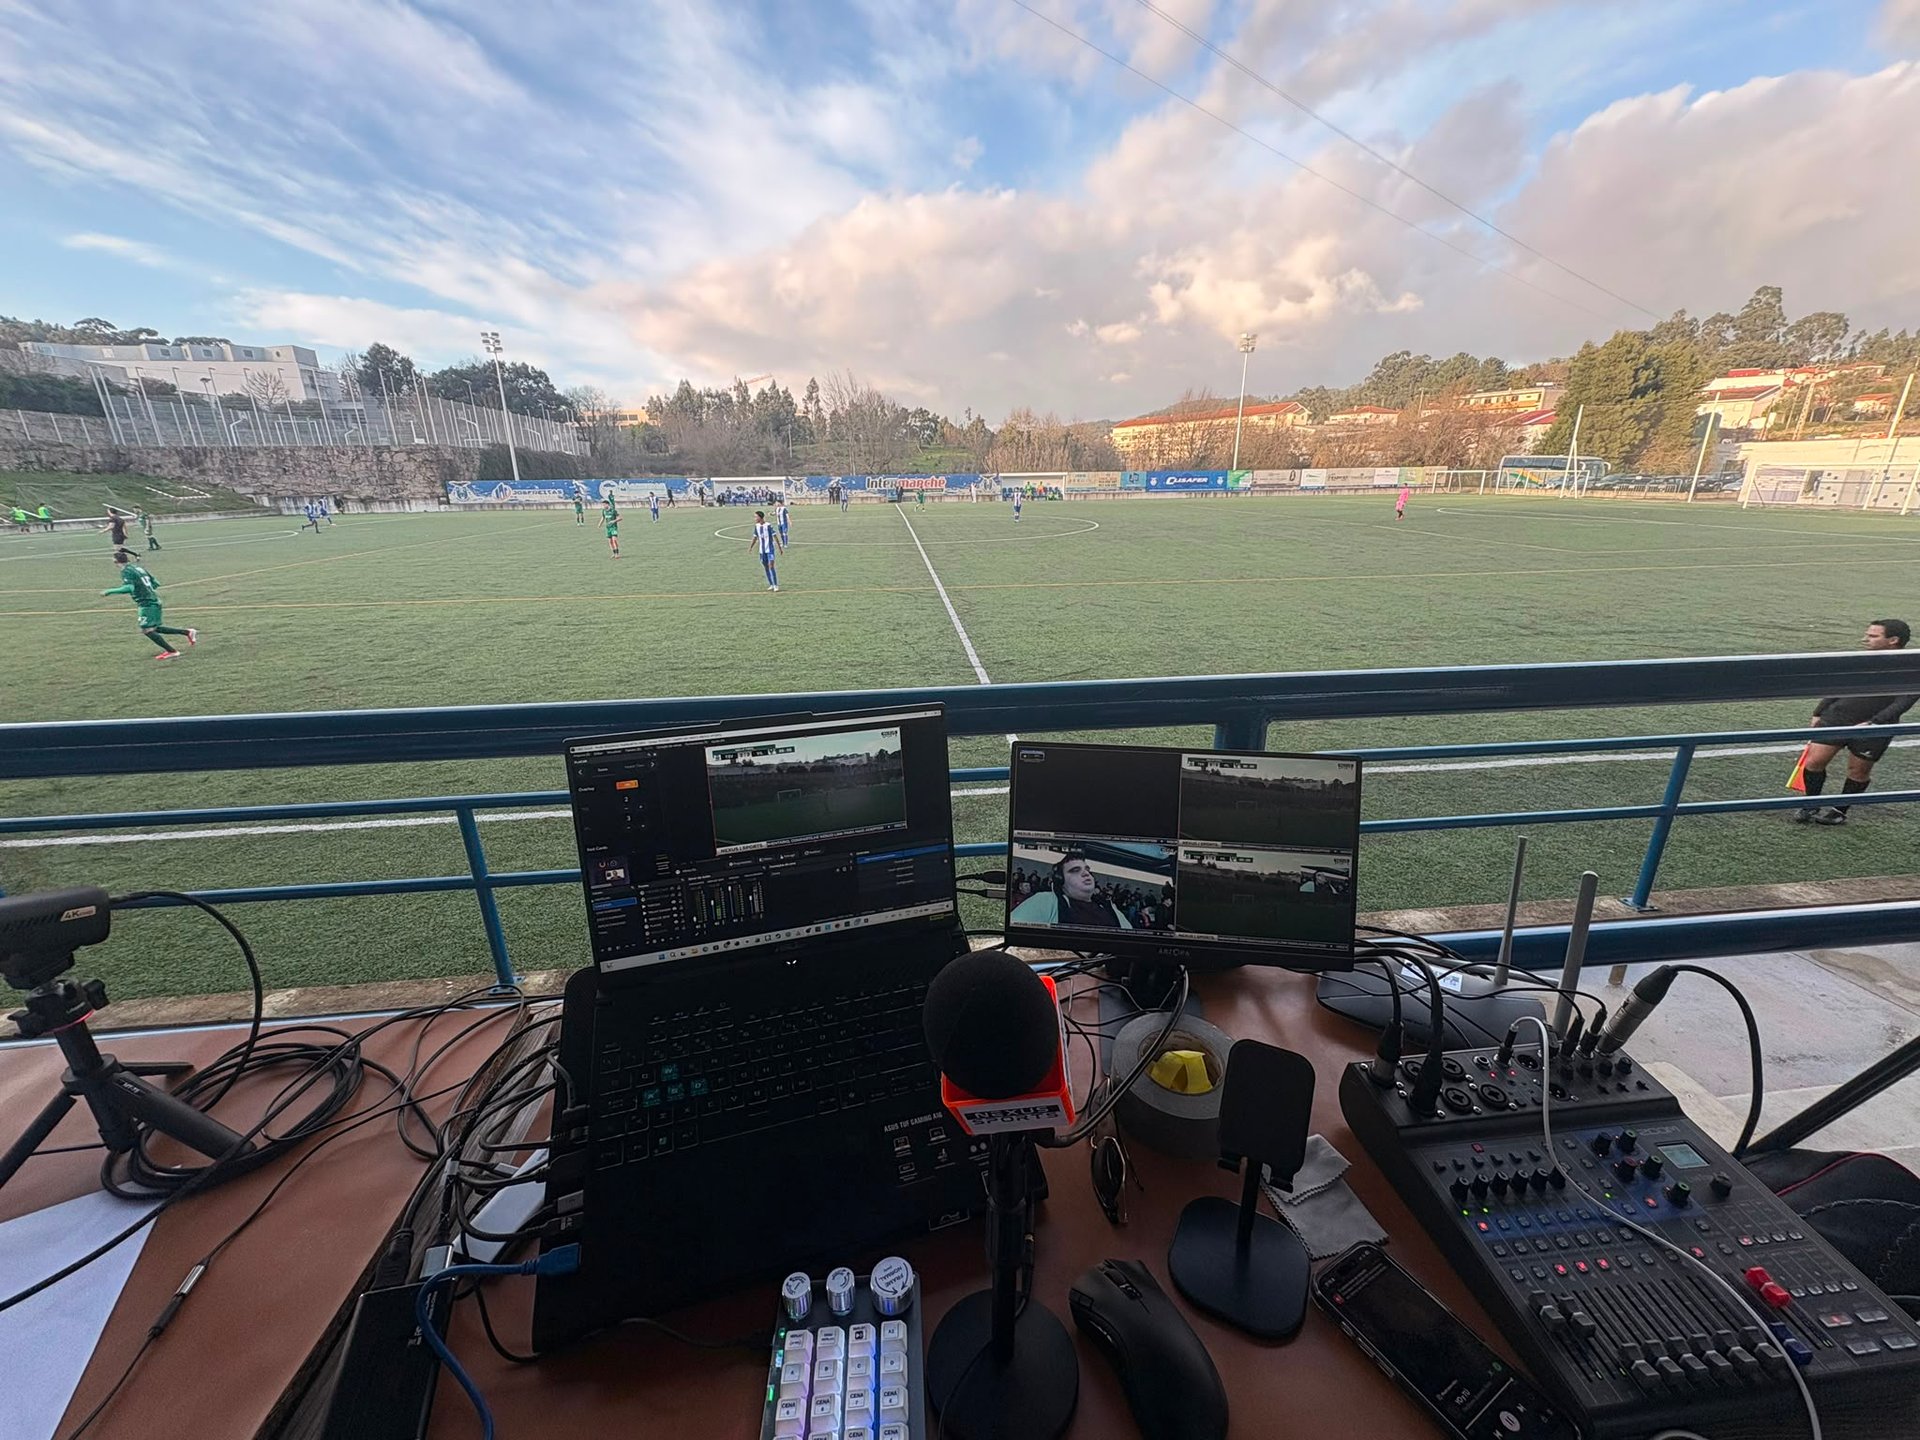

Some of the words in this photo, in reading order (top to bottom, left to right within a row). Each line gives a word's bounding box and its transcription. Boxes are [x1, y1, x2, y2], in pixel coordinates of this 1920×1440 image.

[65, 910, 79, 919] 4K
[972, 1112, 1058, 1125] SPORTS
[974, 1106, 1049, 1119] NEXUS
[883, 1121, 899, 1133] ASUS
[899, 1118, 910, 1129] TUF
[910, 1114, 932, 1126] GAMING
[879, 1266, 903, 1282] NORMAL
